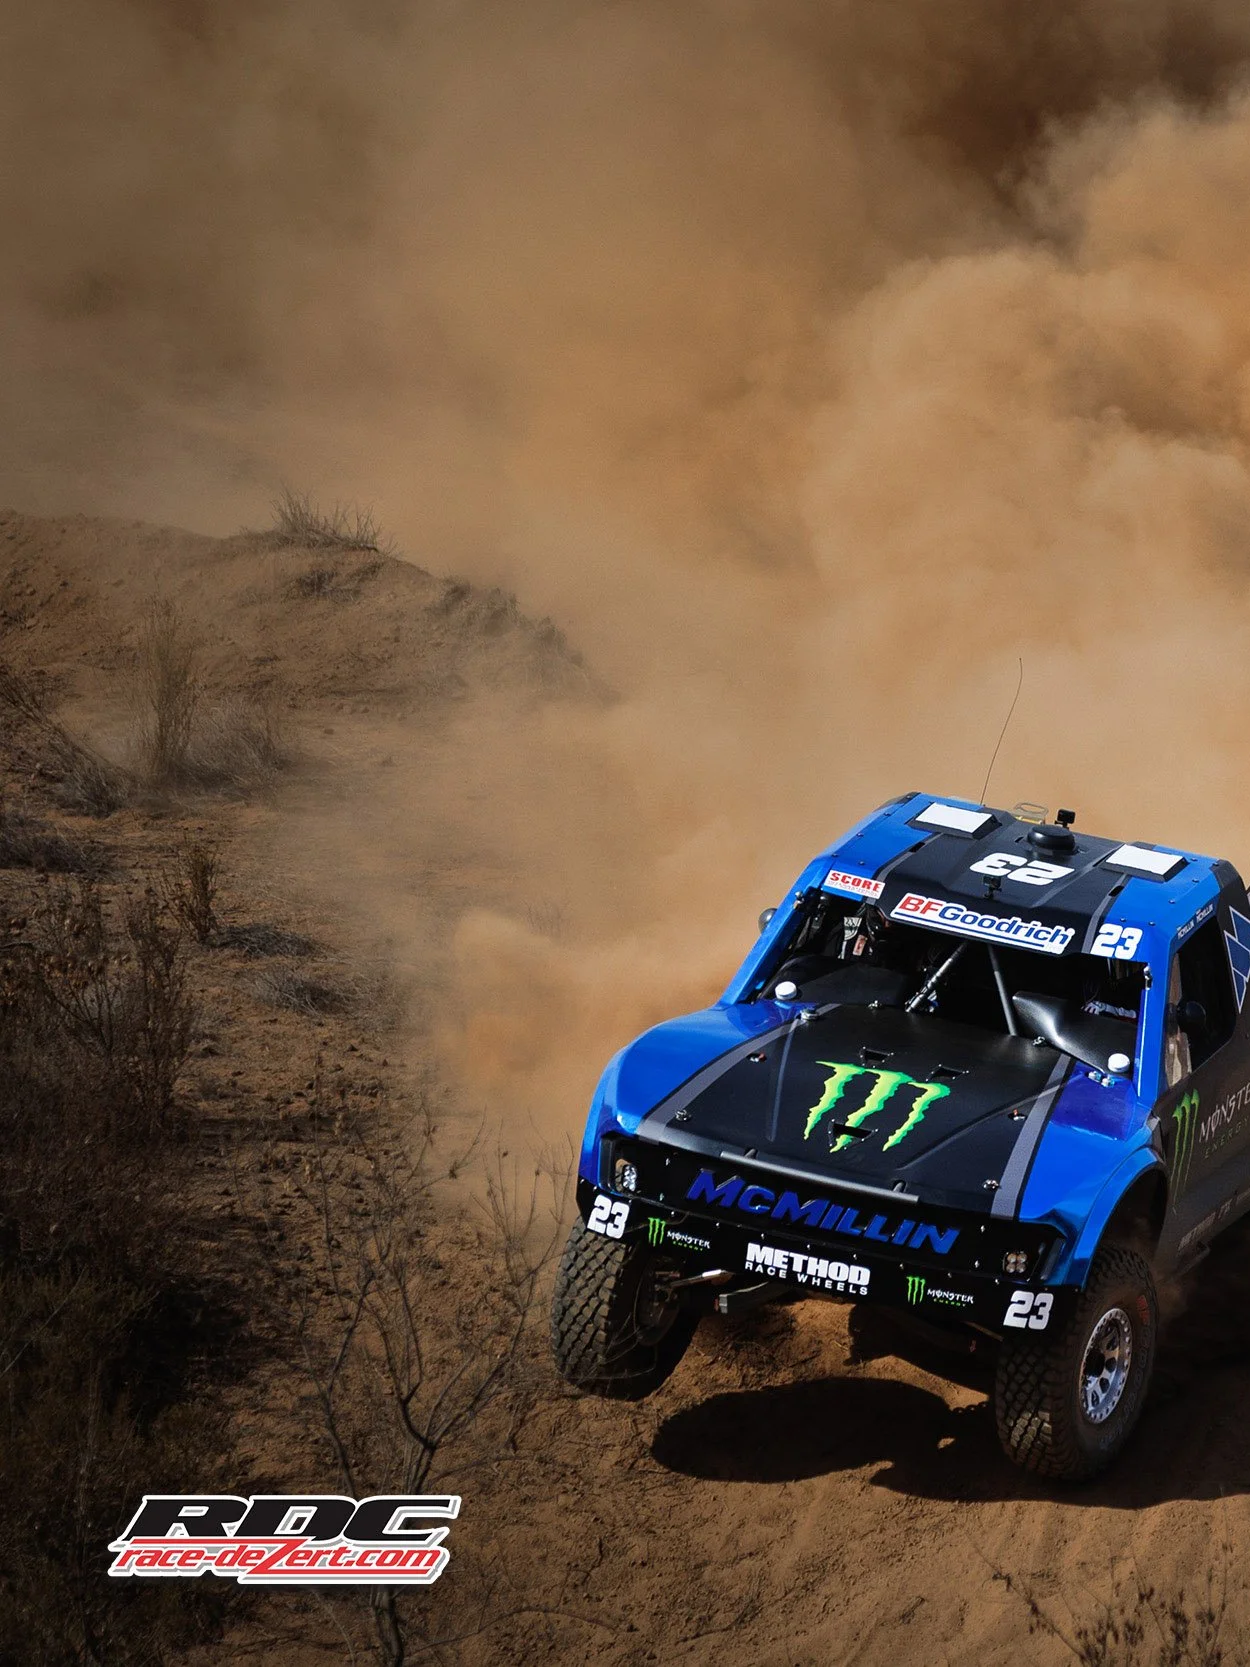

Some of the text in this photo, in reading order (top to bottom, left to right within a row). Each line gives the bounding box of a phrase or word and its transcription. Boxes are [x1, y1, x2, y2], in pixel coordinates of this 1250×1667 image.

[830, 872, 881, 893] SCORE
[970, 853, 1075, 886] 23
[898, 896, 1069, 945] BFGoodrich
[1090, 923, 1143, 960] 23
[587, 1194, 630, 1240] 23
[666, 1230, 711, 1249] MONSTER
[744, 1261, 869, 1296] RACE WHEELS
[746, 1242, 871, 1286] METHOD
[926, 1288, 974, 1305] MONSTER
[1003, 1290, 1054, 1330] 23
